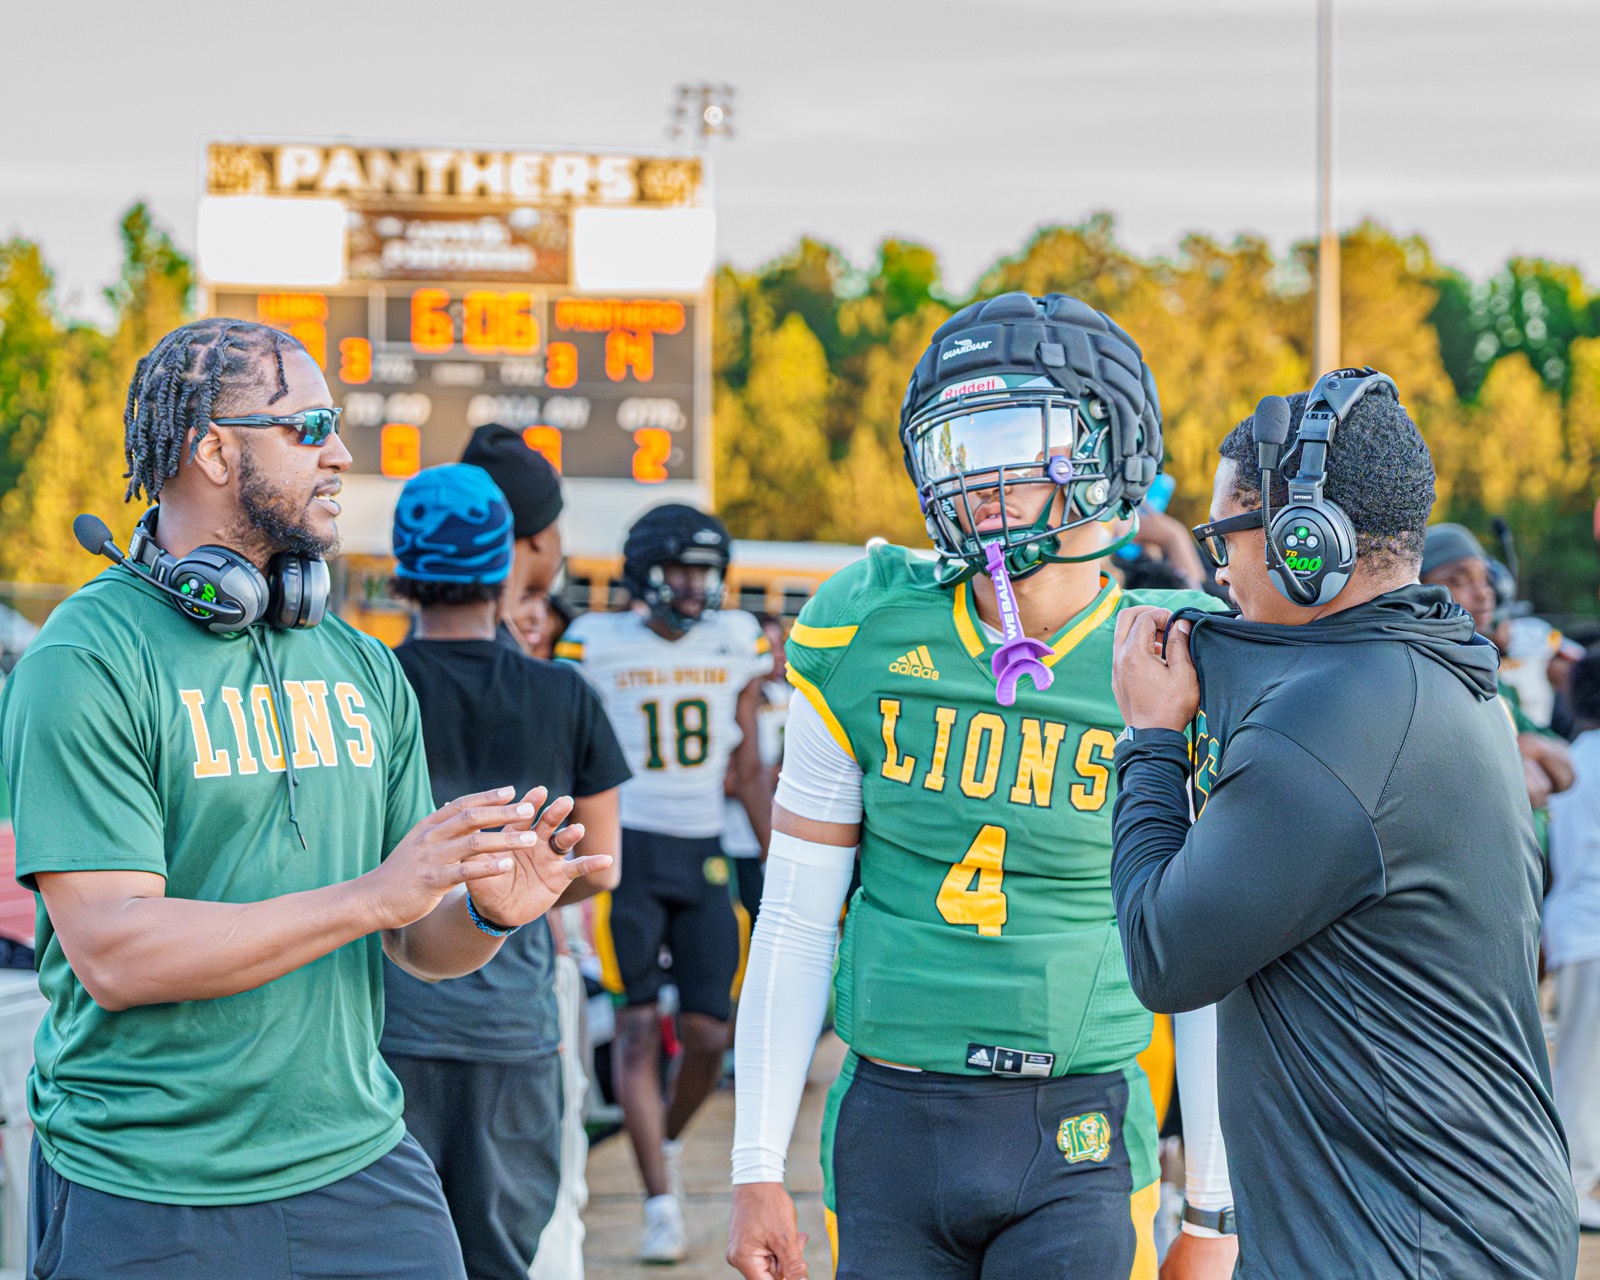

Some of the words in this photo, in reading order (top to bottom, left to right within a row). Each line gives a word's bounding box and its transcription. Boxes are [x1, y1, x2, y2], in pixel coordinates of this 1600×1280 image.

[278, 147, 634, 200] PANTHERS
[943, 341, 990, 360] GUARDIAN
[945, 379, 995, 399] Riddell
[1286, 557, 1322, 571] 900
[995, 570, 1012, 612] BALL
[1003, 612, 1017, 641] WE
[888, 662, 940, 681] adidas
[179, 680, 375, 778] LIONS
[640, 699, 709, 771] 18
[879, 698, 1116, 812] LIONS
[935, 823, 1008, 937] 4
